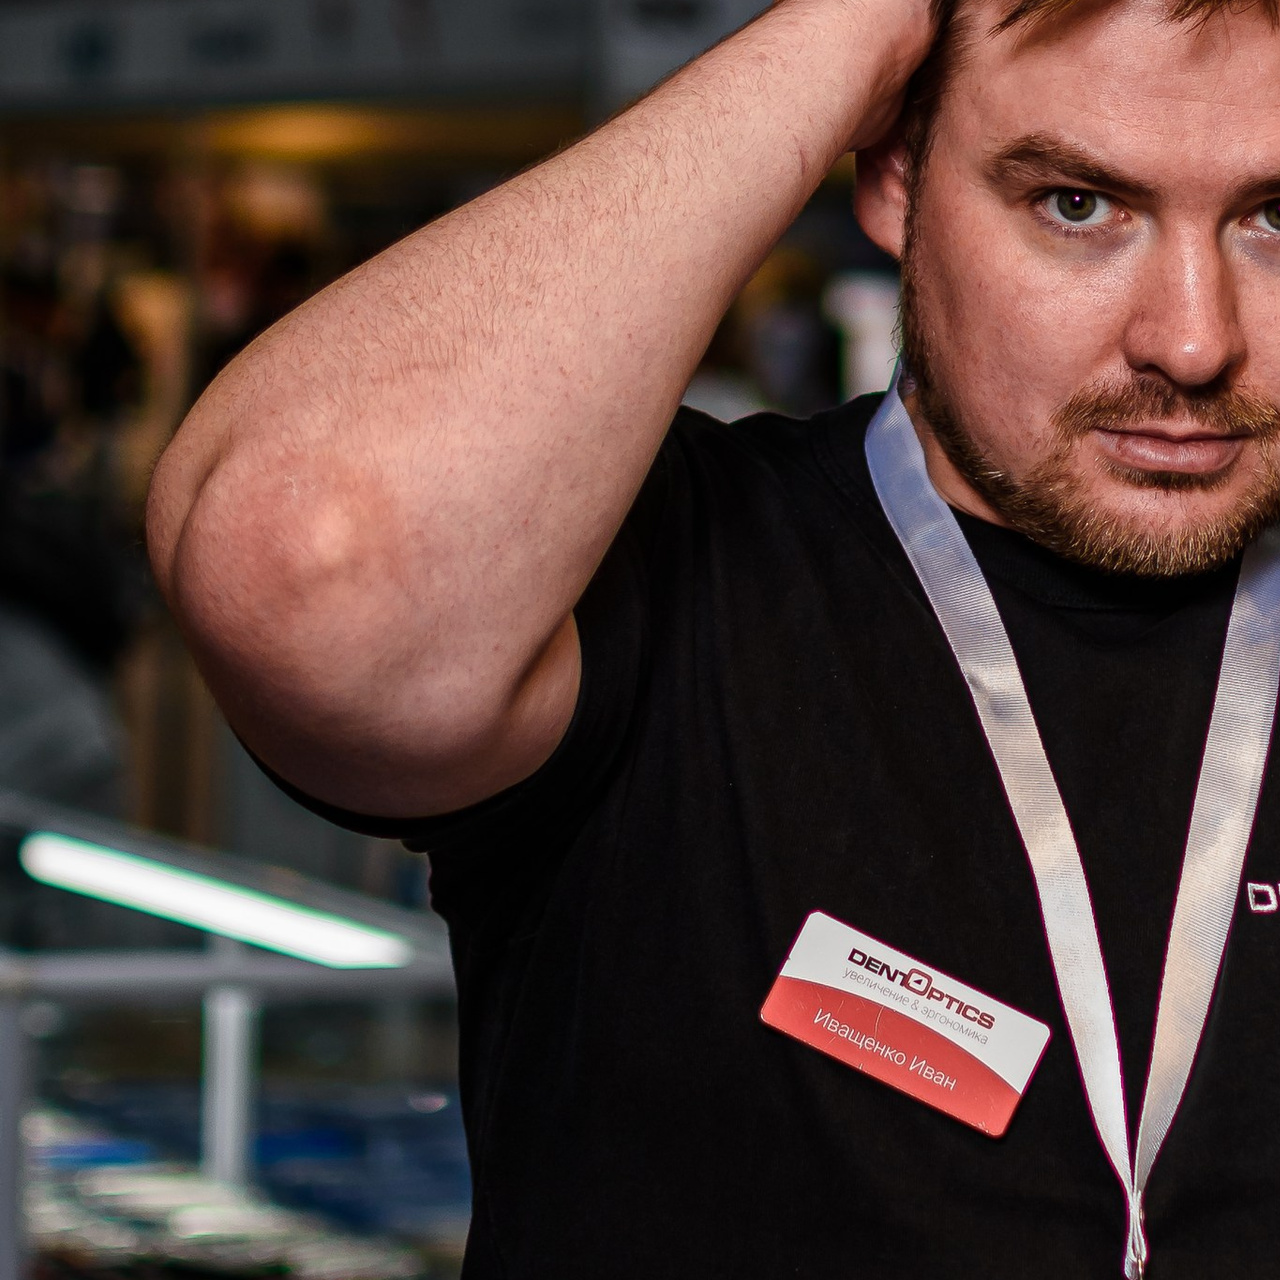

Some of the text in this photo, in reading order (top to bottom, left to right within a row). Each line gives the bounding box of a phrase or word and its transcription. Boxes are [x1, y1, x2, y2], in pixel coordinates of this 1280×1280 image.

[842, 967, 989, 1045] увеличение & эргономика
[813, 1008, 958, 1091] Иващенко Иван
